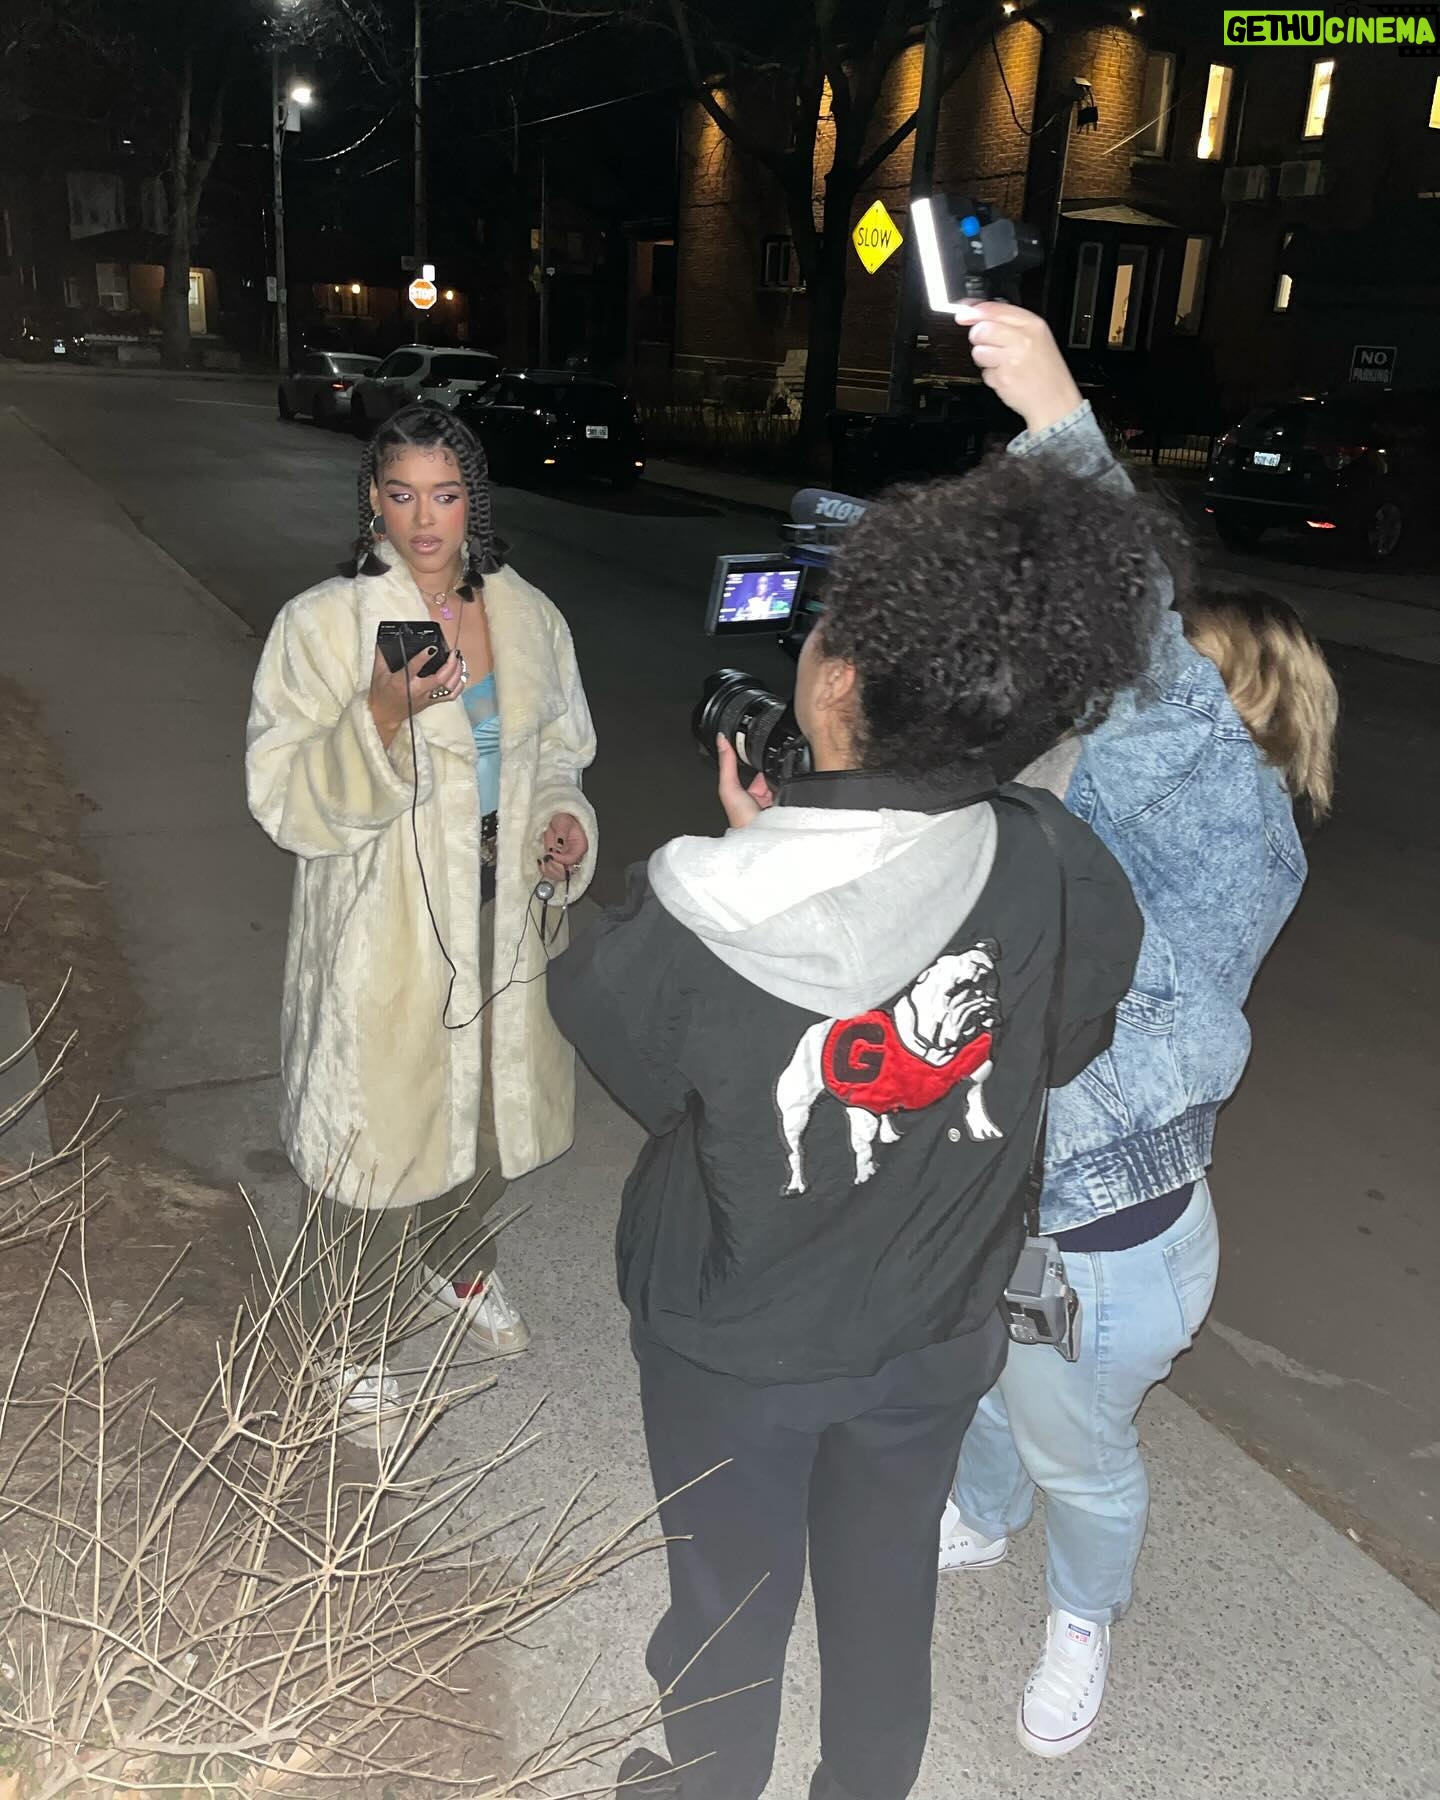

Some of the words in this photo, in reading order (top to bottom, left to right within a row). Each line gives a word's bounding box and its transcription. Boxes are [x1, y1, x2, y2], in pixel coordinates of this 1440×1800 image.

[857, 227, 892, 249] SLOW
[410, 287, 436, 300] STOP
[1361, 350, 1387, 365] NO
[833, 1022, 886, 1083] G
